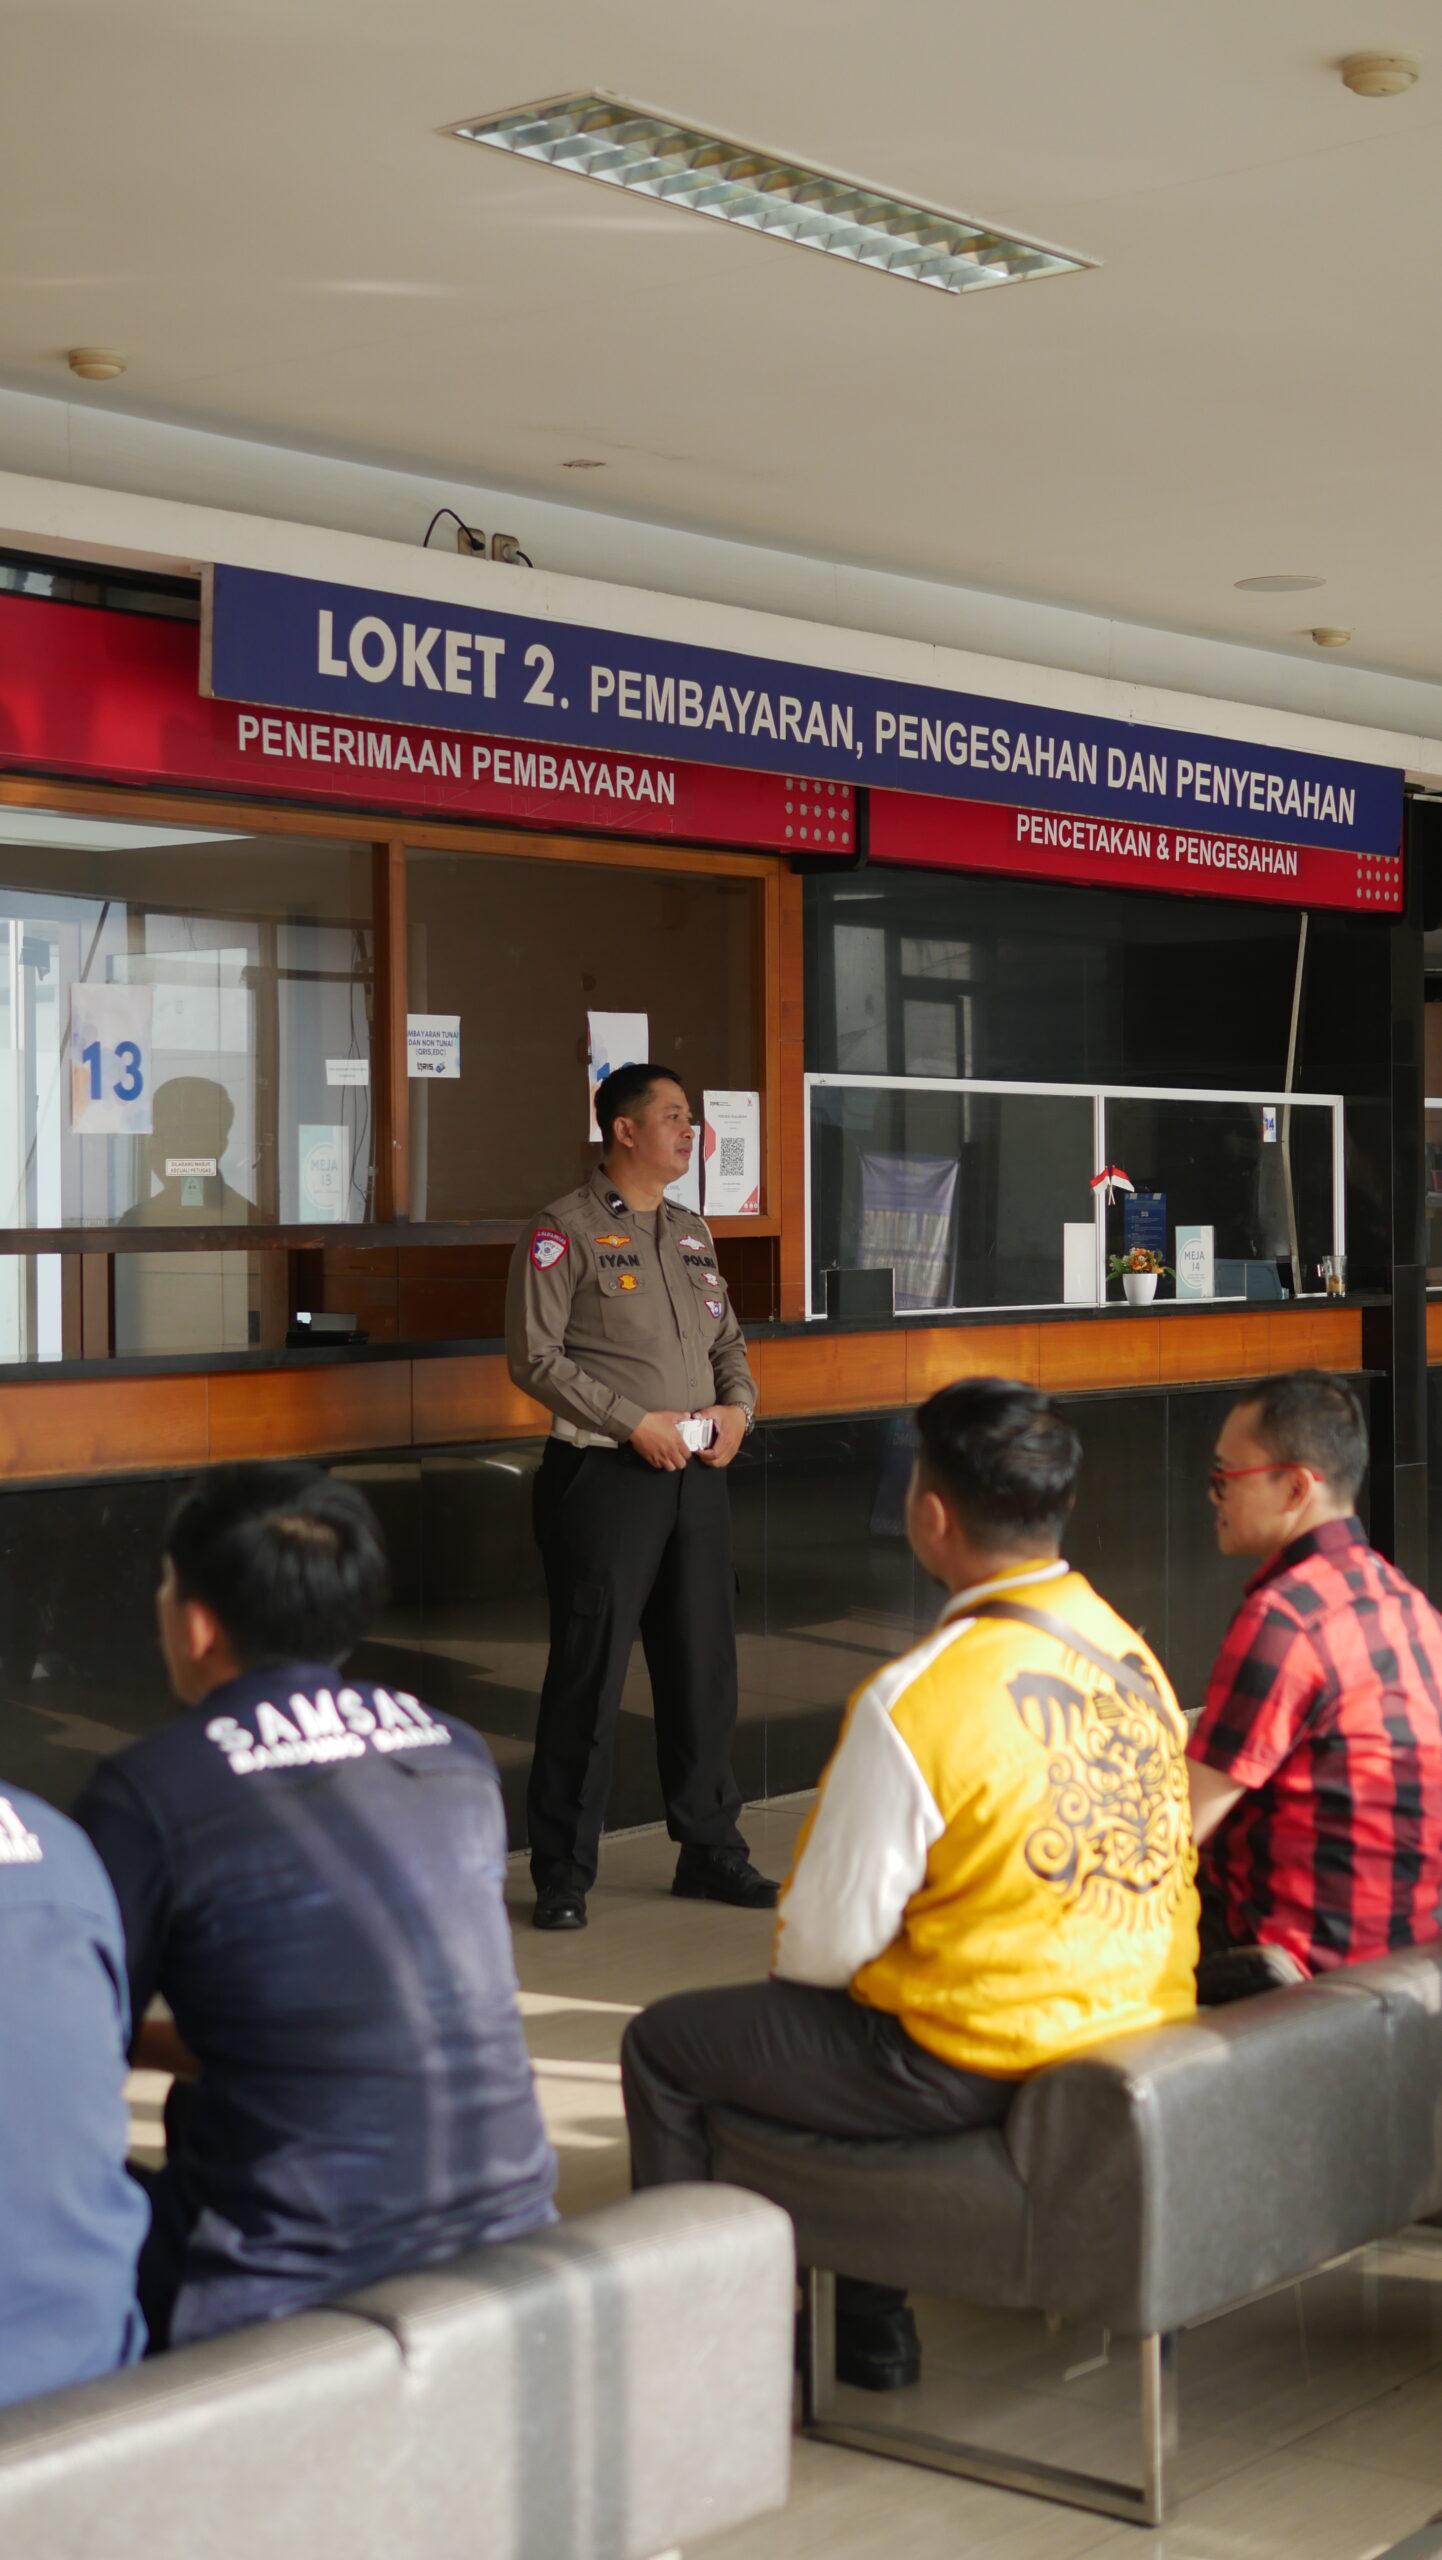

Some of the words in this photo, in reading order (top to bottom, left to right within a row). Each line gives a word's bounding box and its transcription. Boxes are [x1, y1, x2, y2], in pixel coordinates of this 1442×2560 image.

[317, 608, 506, 699] LOKET
[523, 643, 569, 710] 2.
[590, 665, 863, 760] PEMBAYARAN,
[875, 710, 1098, 785] PENGESAHAN
[1107, 747, 1168, 796] DAN
[1176, 758, 1356, 826] PENYERAHAN
[237, 714, 462, 779] PENERIMAAN
[472, 745, 676, 806] PEMBAYARAN
[1016, 813, 1151, 858] PENCETAKAN
[1156, 832, 1170, 861] &
[1175, 835, 1298, 876] PENGESAHAN
[82, 1041, 143, 1101] 13
[1264, 1117, 1275, 1131] 14
[311, 1159, 338, 1171] MEJA
[598, 1254, 640, 1269] IYAN
[682, 1254, 716, 1269] POLRI
[1184, 1250, 1205, 1260] MEJA
[1192, 1262, 1200, 1271] 14
[206, 1687, 434, 1753] SAMSAT
